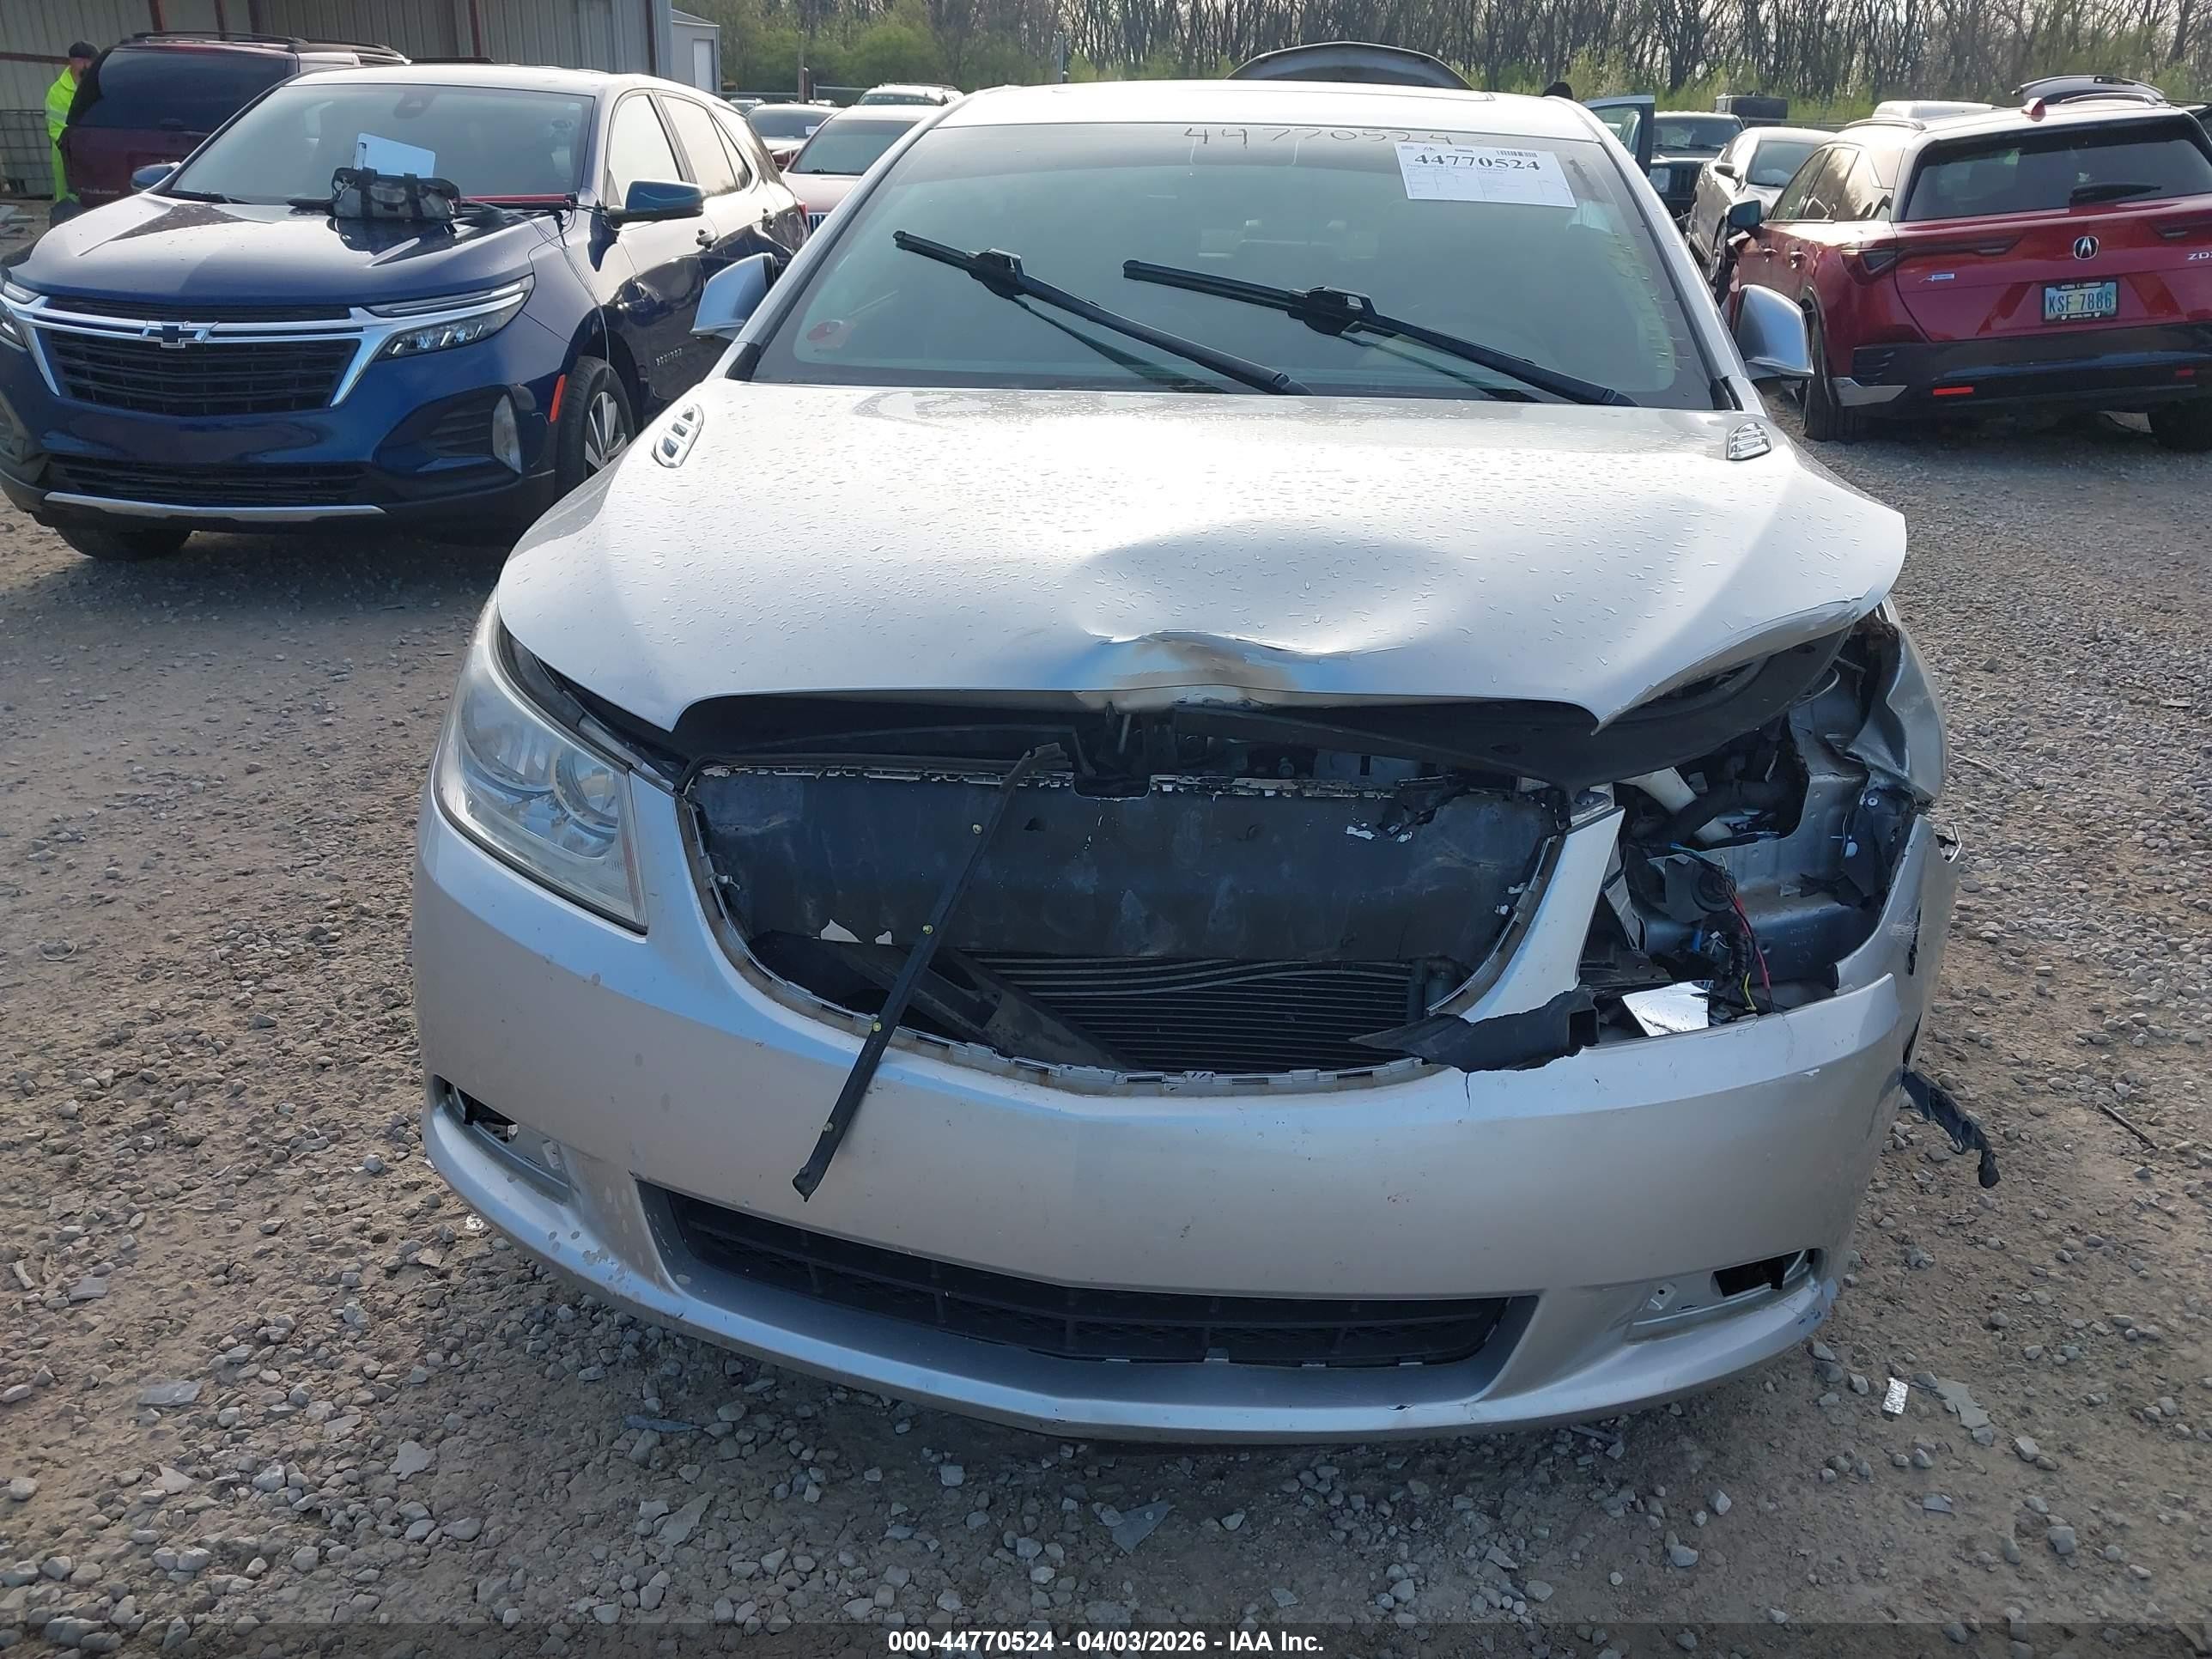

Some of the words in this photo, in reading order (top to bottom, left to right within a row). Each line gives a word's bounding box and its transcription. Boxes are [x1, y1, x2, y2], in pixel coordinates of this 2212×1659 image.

[1414, 154, 1540, 170] 44770524
[2049, 295, 2074, 313] KSF
[2079, 291, 2112, 311] 7886
